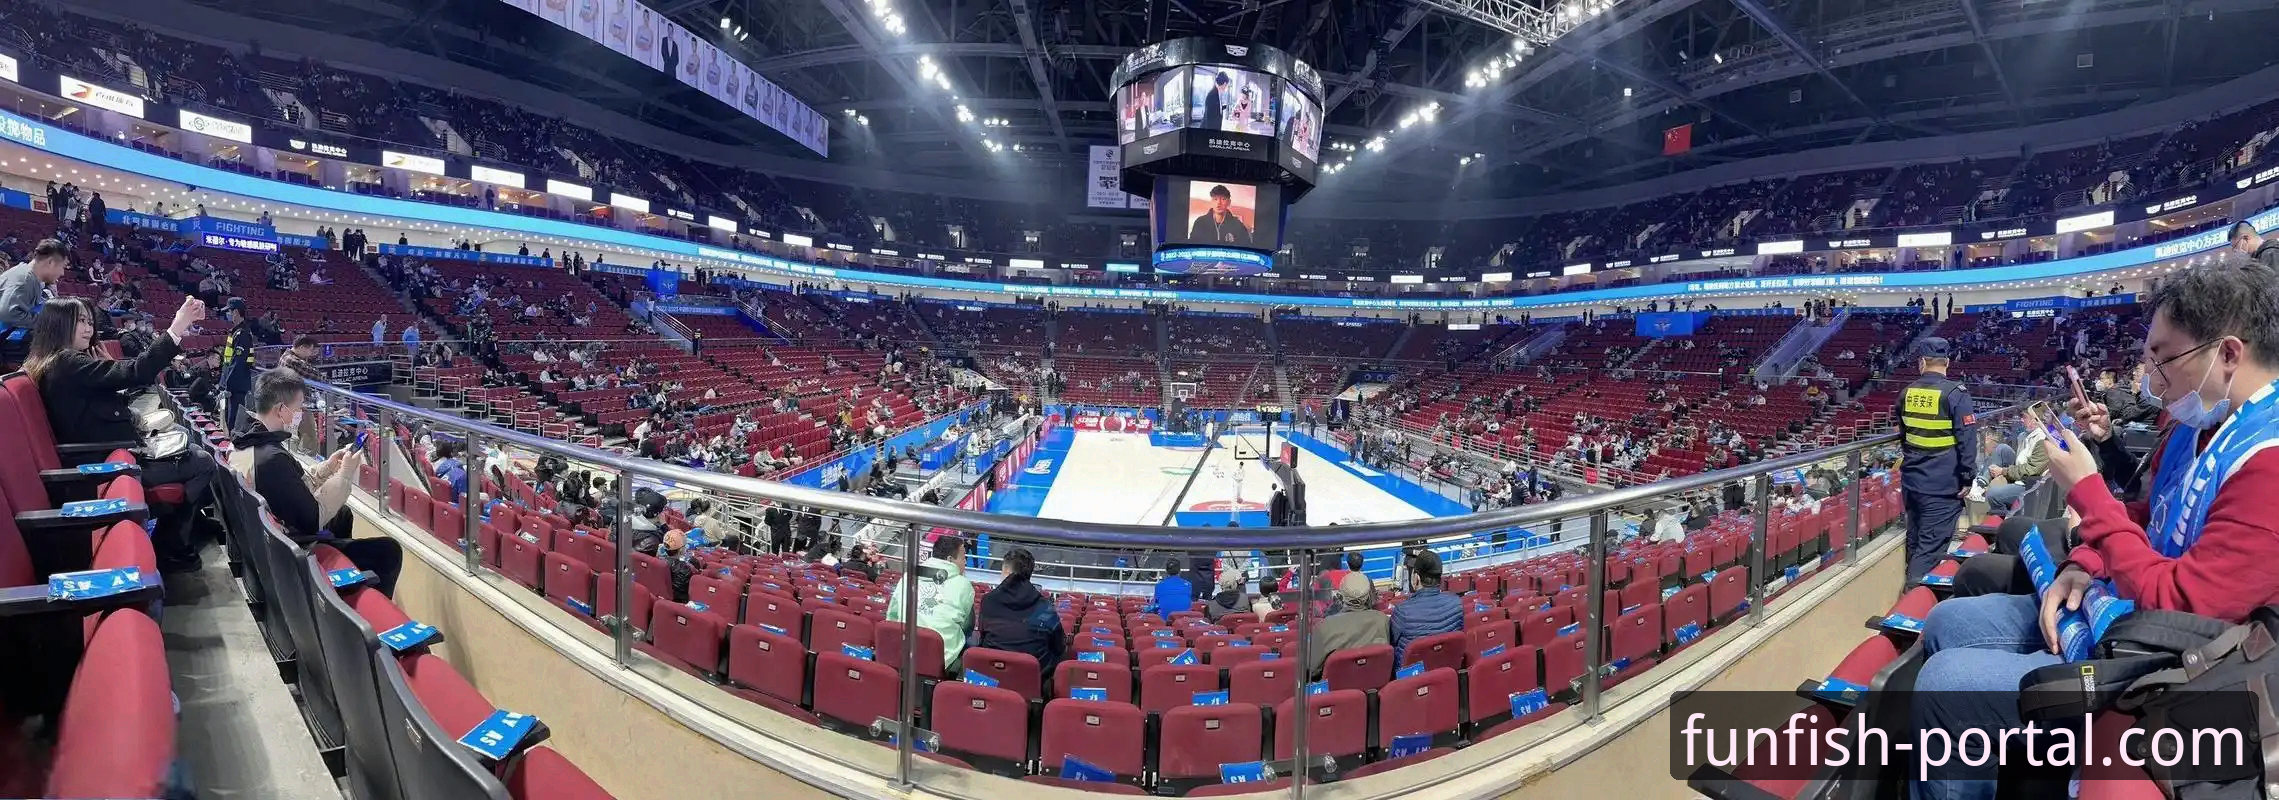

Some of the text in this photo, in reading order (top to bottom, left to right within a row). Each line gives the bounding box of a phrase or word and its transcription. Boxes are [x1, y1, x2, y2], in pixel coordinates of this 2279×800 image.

[216, 221, 265, 237] FIGHTING
[2015, 299, 2054, 308] FIGHTING
[331, 366, 369, 378] 凯迪拉克中心
